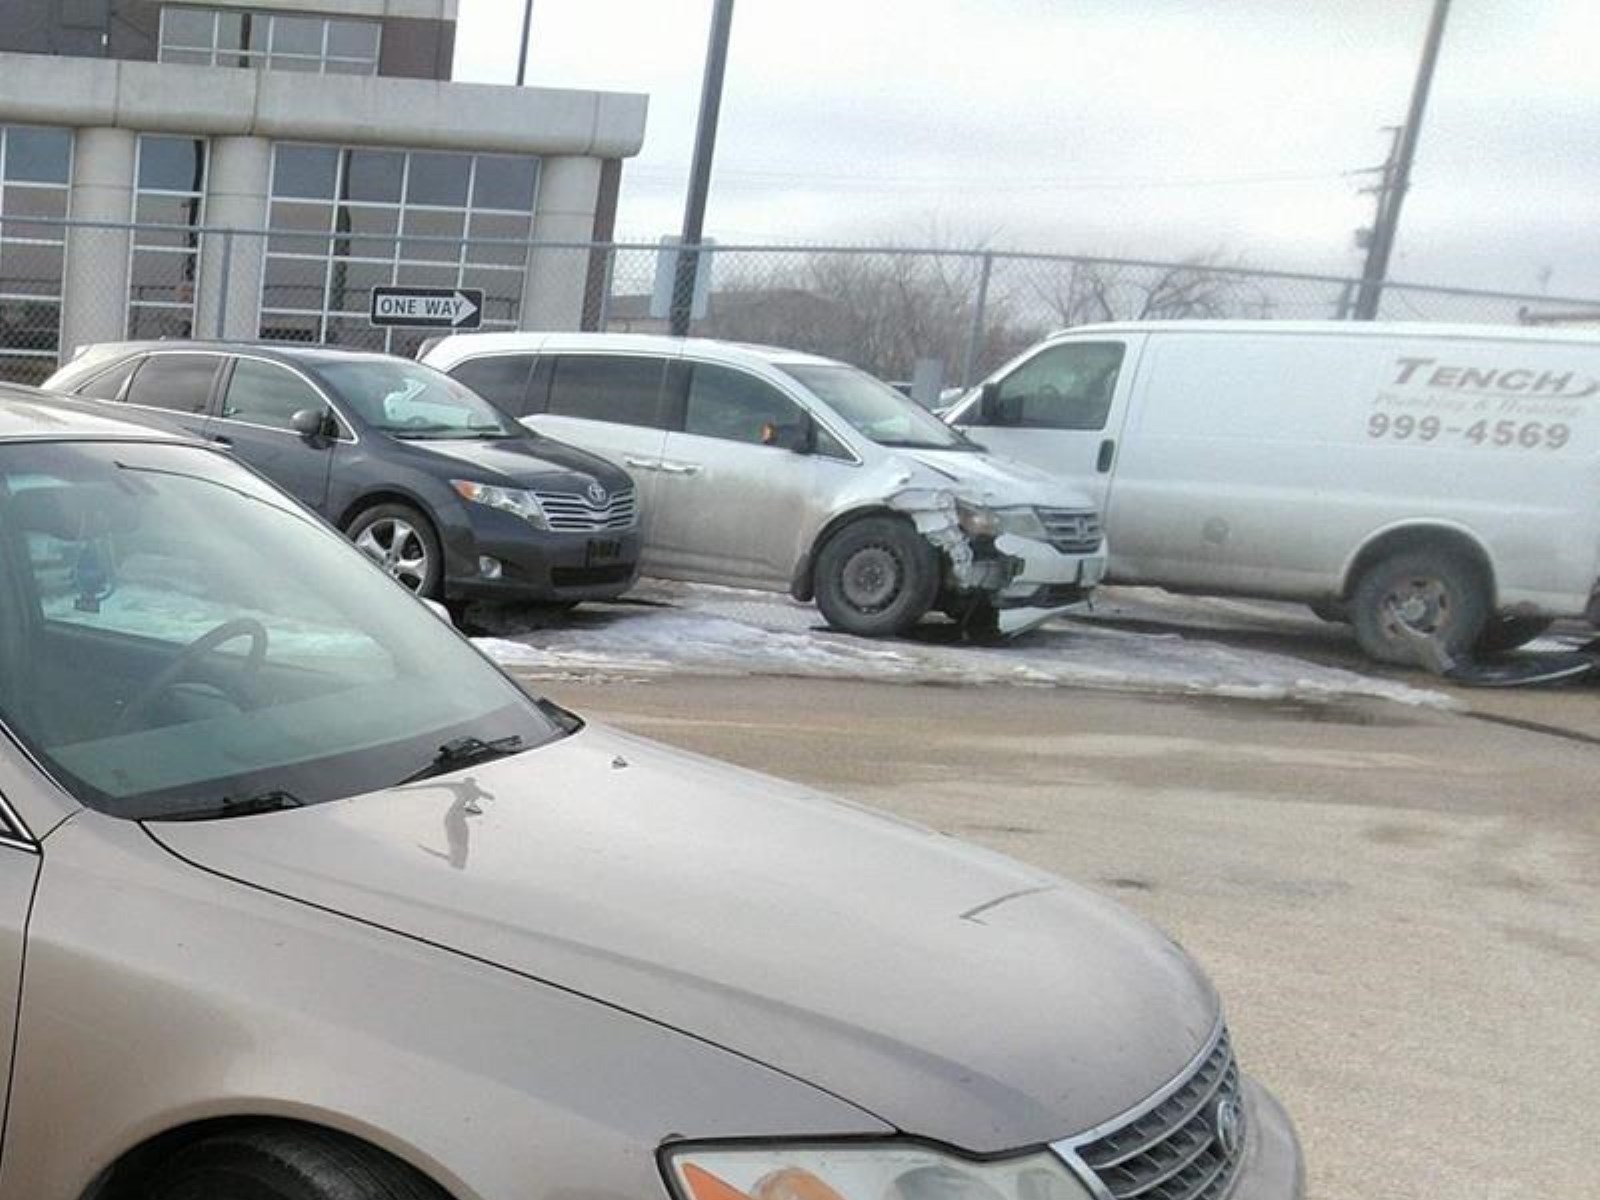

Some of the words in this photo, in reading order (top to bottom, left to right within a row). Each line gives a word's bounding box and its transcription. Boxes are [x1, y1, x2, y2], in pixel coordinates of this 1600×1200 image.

[381, 298, 417, 314] ONE
[425, 299, 463, 316] WAY
[1393, 357, 1575, 393] TENCH
[1367, 412, 1570, 450] 999-4569
